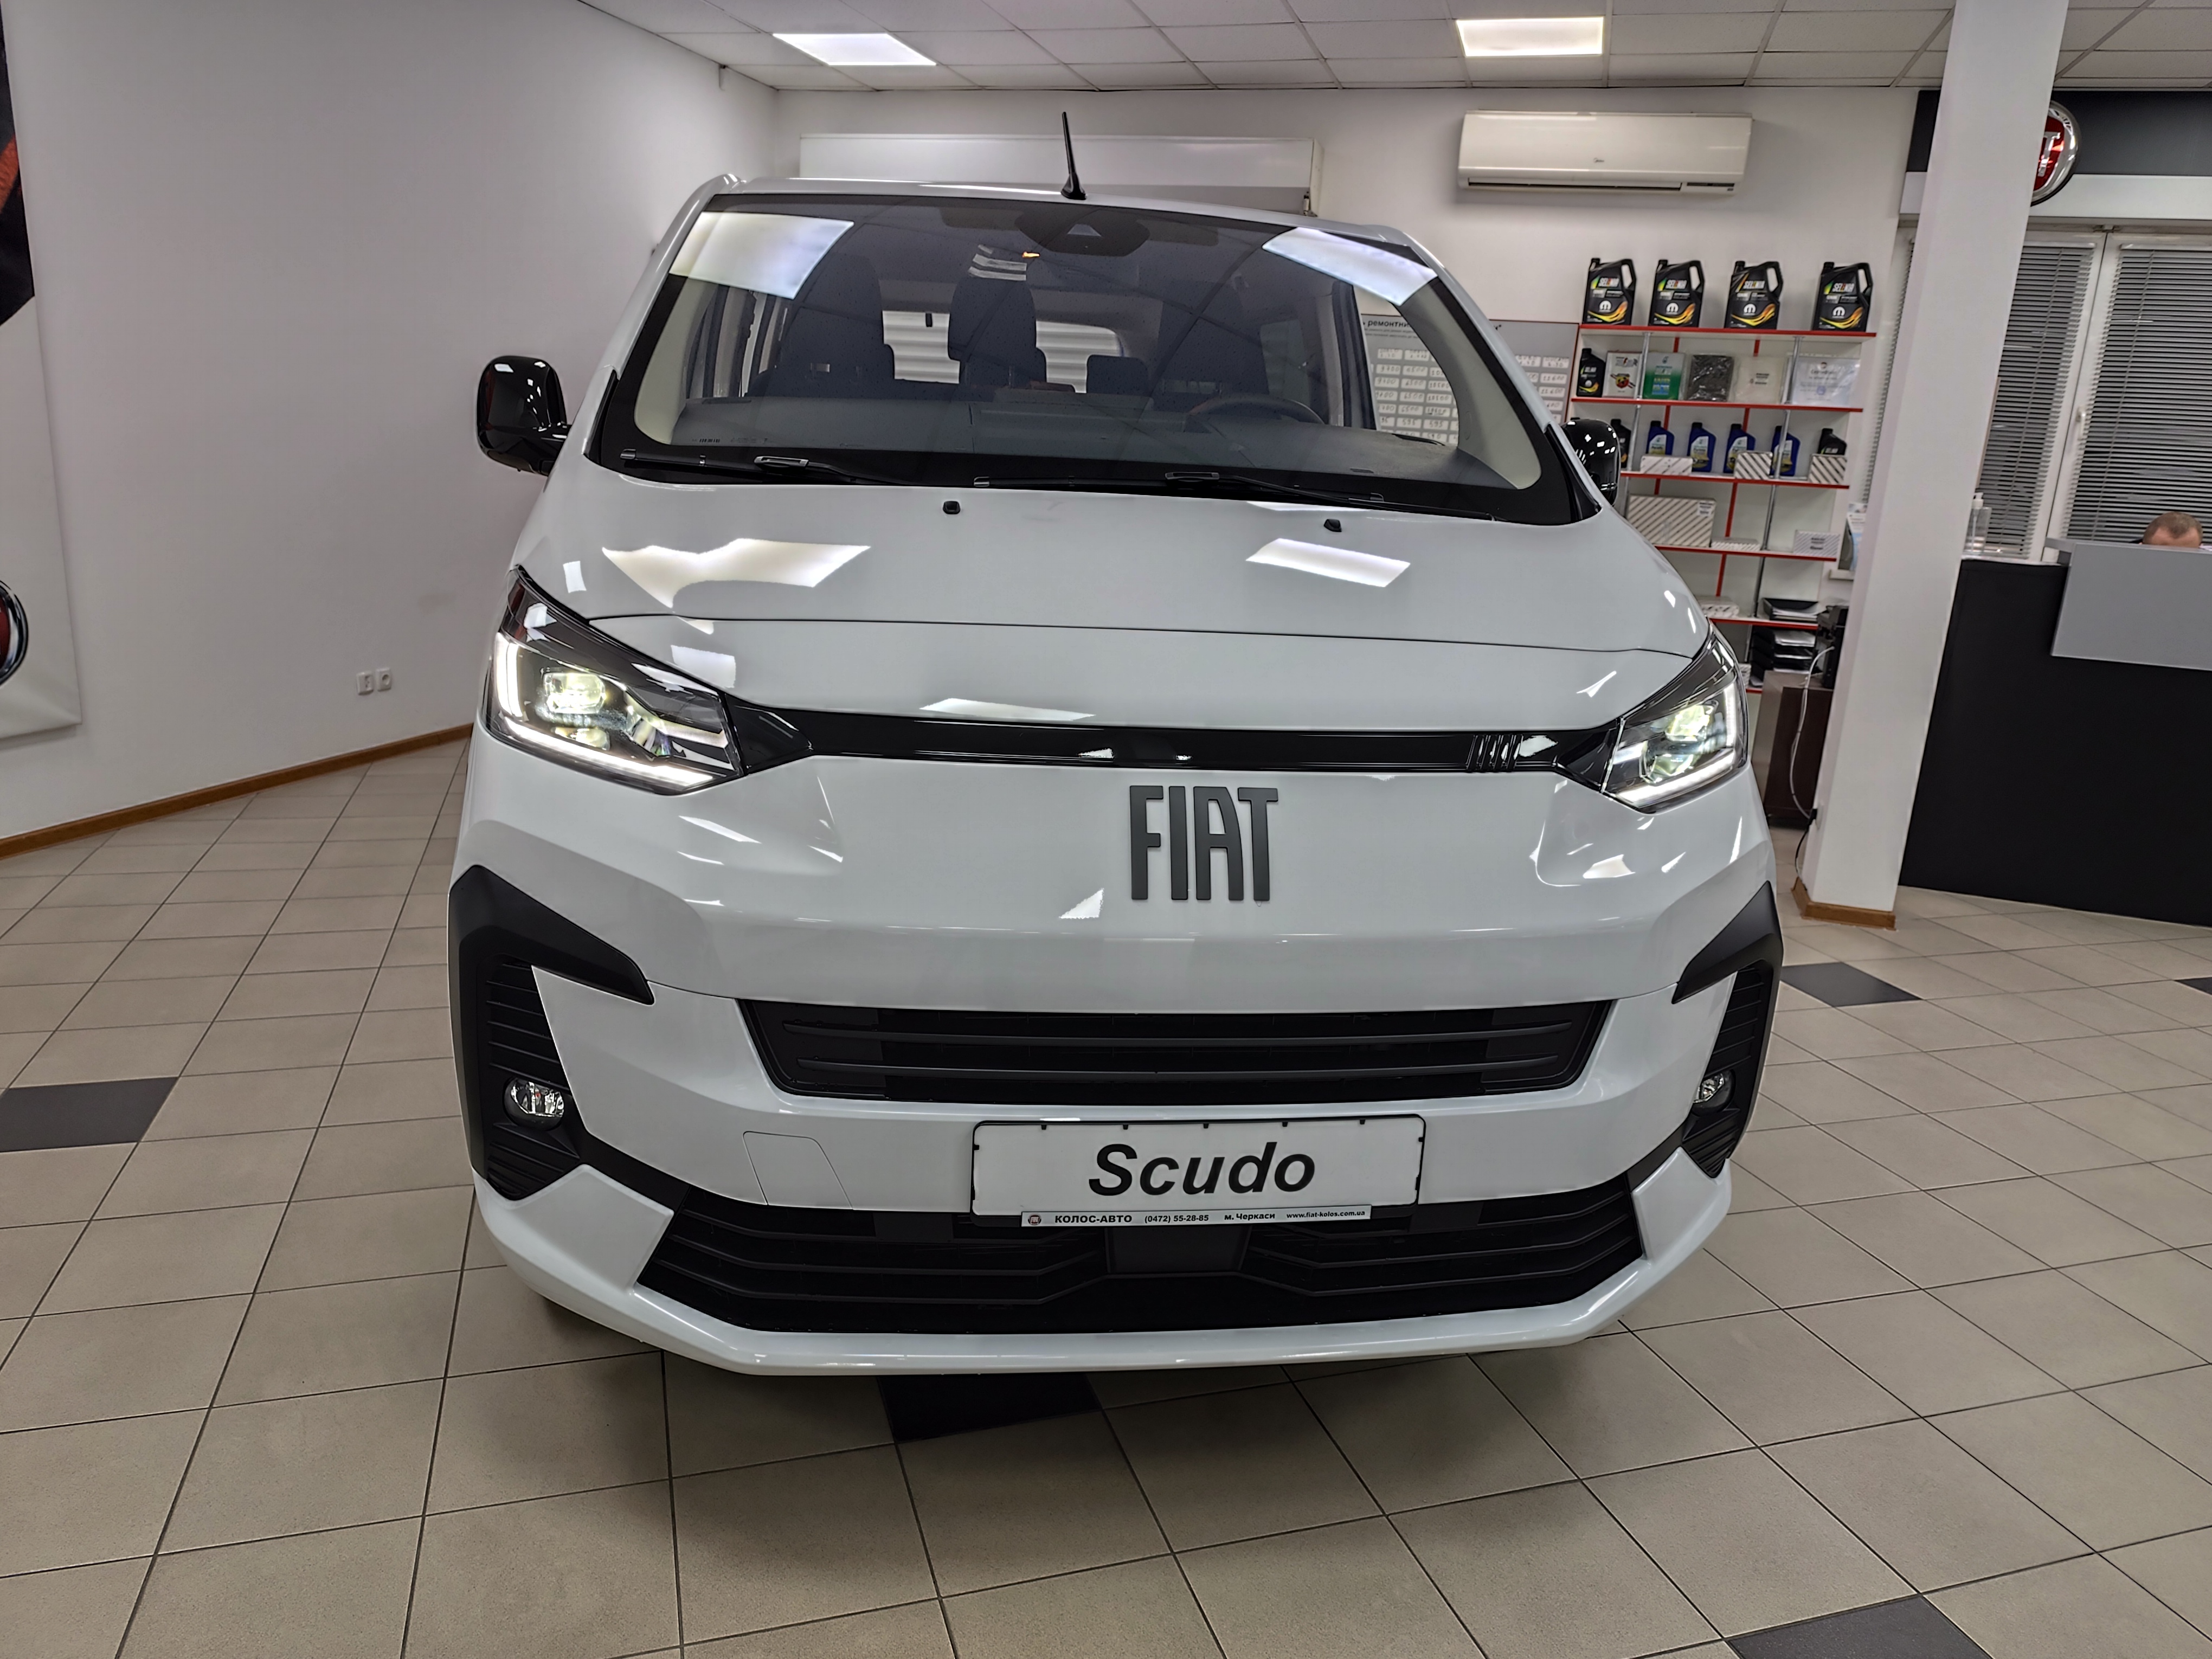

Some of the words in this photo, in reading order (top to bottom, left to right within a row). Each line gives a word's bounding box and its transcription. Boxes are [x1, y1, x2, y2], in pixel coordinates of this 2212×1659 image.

[1129, 785, 1278, 901] FIAT
[1089, 1141, 1315, 1196] Scudo
[1054, 1214, 1133, 1224] КОЛОС-АВТО
[1144, 1214, 1171, 1224] (0472)
[1173, 1214, 1210, 1222] 55-28-85
[1236, 1212, 1276, 1221] Черкаси
[1286, 1210, 1365, 1219] www.fiat-kolos.com.ua
